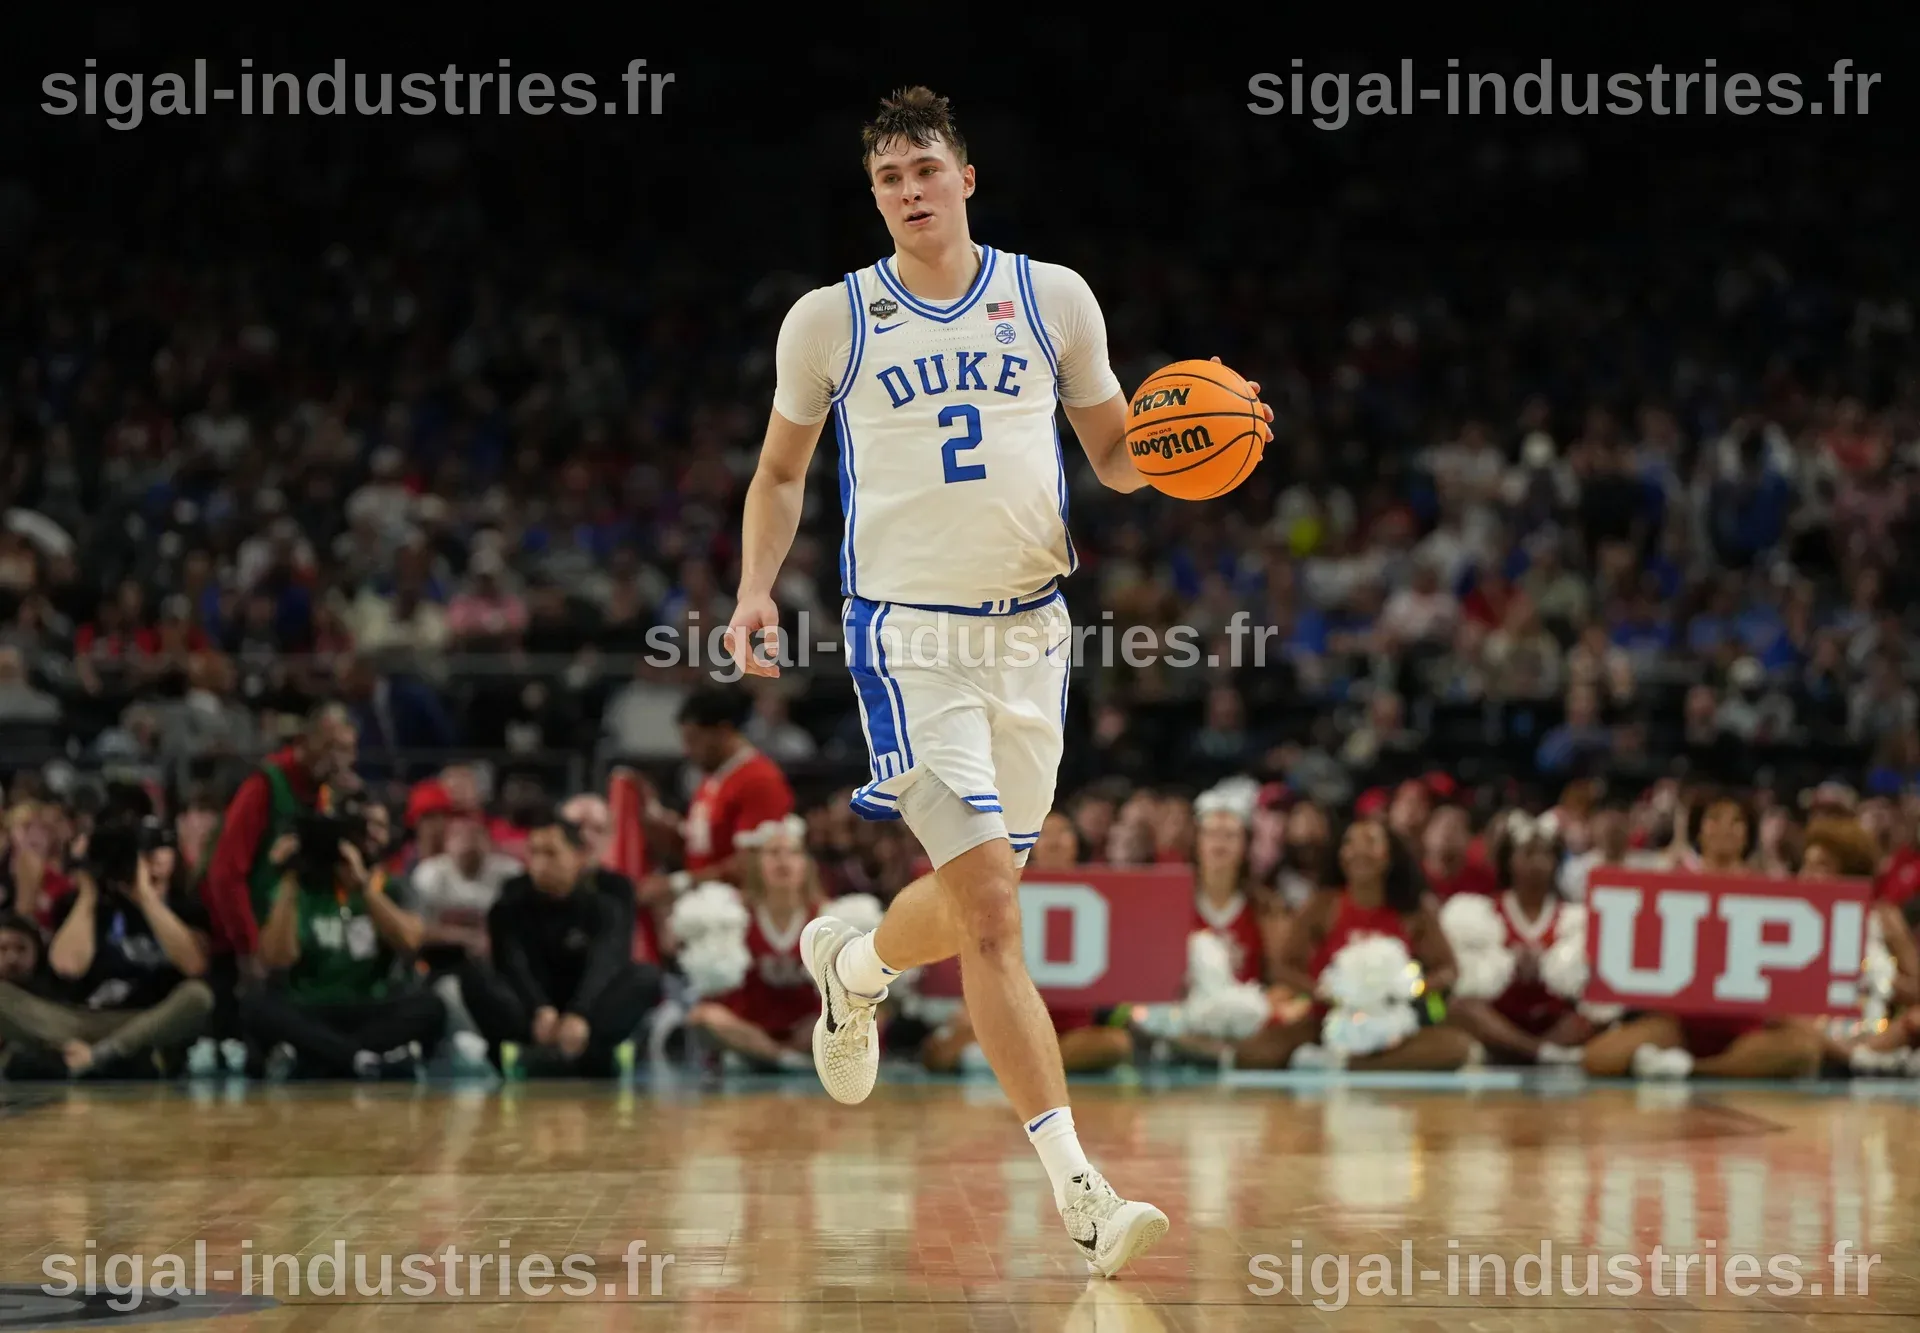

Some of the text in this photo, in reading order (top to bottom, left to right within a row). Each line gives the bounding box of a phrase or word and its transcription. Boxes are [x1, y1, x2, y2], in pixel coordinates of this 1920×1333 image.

[876, 352, 1028, 408] DUKE
[1133, 388, 1191, 417] NCAA
[938, 404, 986, 483] 2
[1130, 425, 1214, 459] Wilson
[1590, 885, 1864, 1007] UP!
